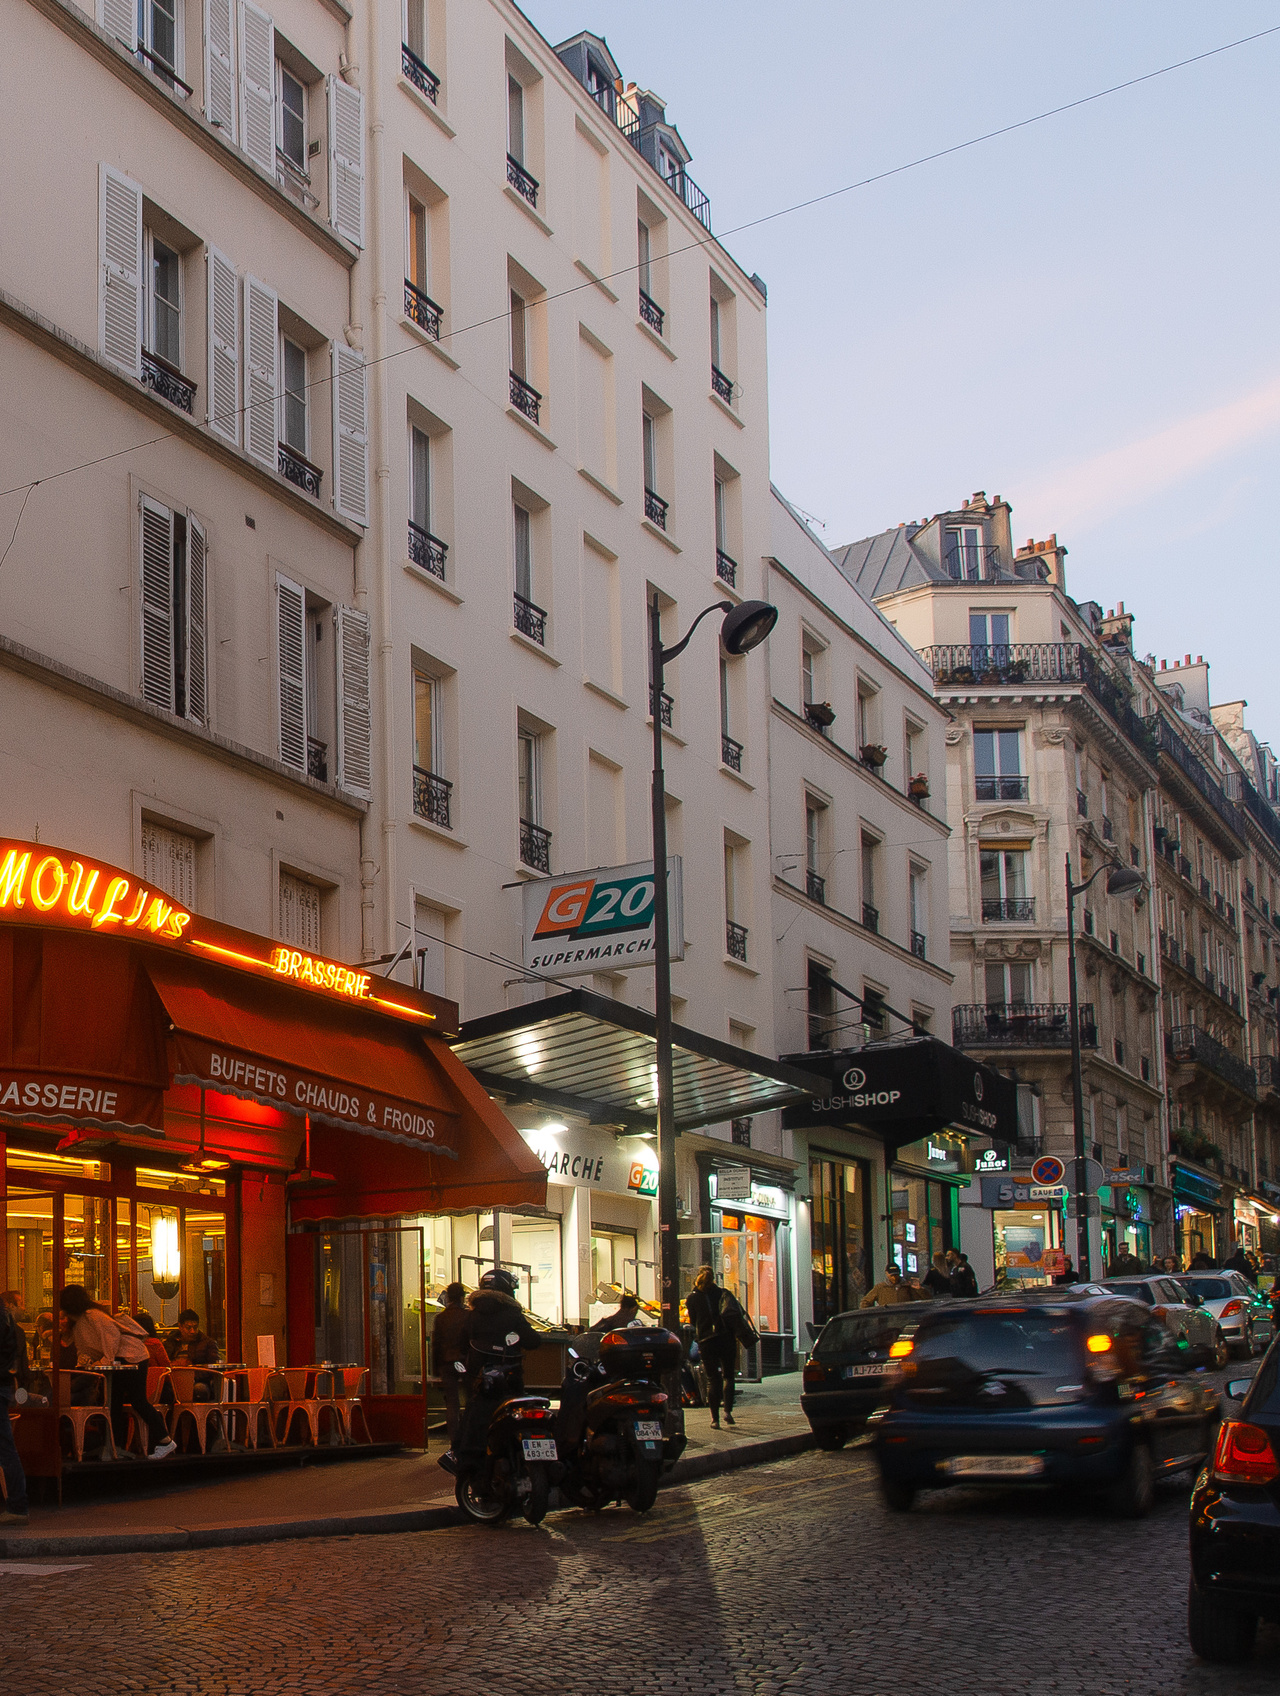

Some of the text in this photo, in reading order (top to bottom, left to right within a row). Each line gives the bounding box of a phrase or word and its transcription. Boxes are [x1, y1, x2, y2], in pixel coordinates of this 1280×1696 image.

[548, 881, 655, 923] G20
[530, 939, 655, 968] SUPERMARCH
[275, 948, 372, 999] BRASSERIE
[210, 1053, 435, 1138] BUFFETS CHAUDS & FROIDS
[631, 1166, 658, 1190] G20
[974, 1159, 1007, 1171] Junot
[854, 1364, 883, 1375] AJ-723
